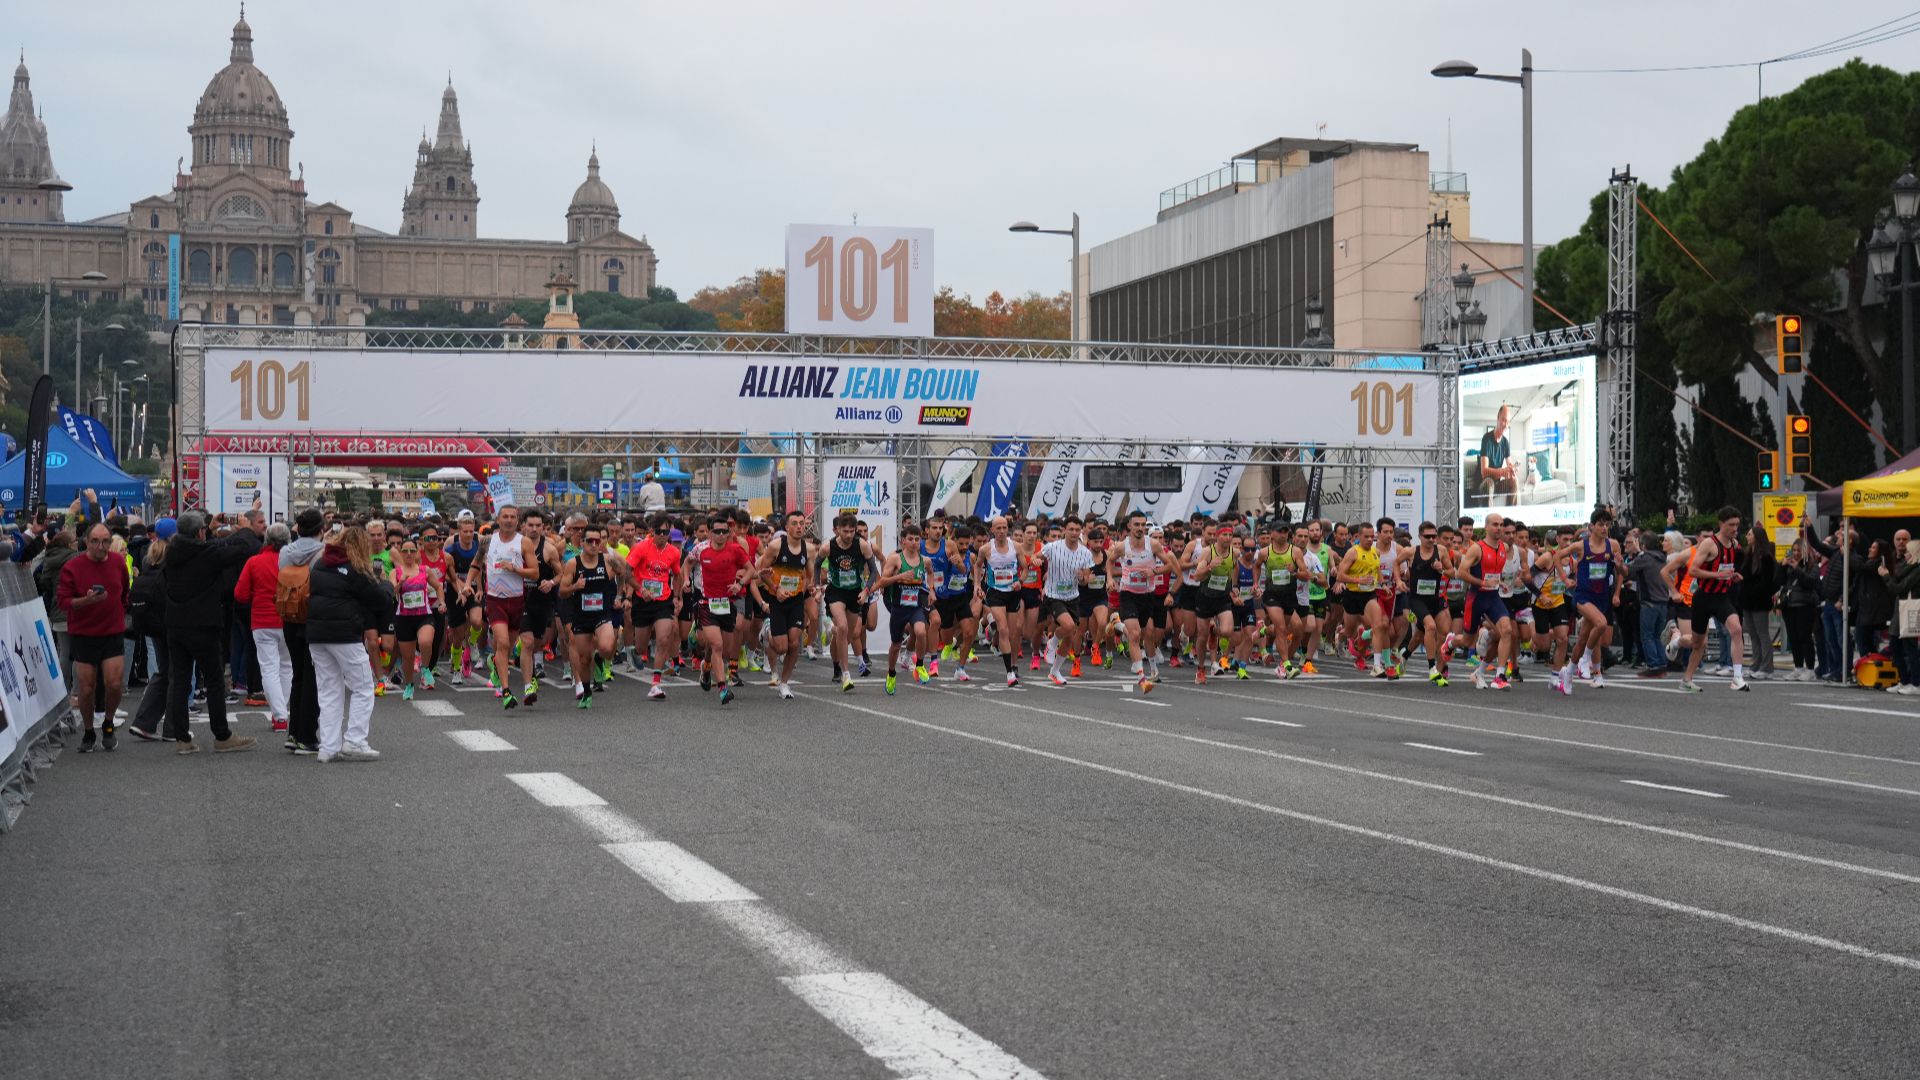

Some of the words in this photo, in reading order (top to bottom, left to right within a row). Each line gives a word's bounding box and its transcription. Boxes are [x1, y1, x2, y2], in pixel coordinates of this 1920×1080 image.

[804, 236, 909, 323] 101
[230, 359, 310, 421] 101
[739, 365, 839, 398] ALLIANZ
[840, 367, 902, 400] JEAN
[903, 368, 980, 401] BOUIN
[835, 407, 882, 421] Allianz
[923, 407, 968, 418] MUNDO
[1350, 381, 1414, 437] 101
[837, 466, 877, 480] ALLIANZ
[598, 480, 614, 499] P
[832, 480, 857, 494] JEAN
[830, 493, 862, 508] BOUIN
